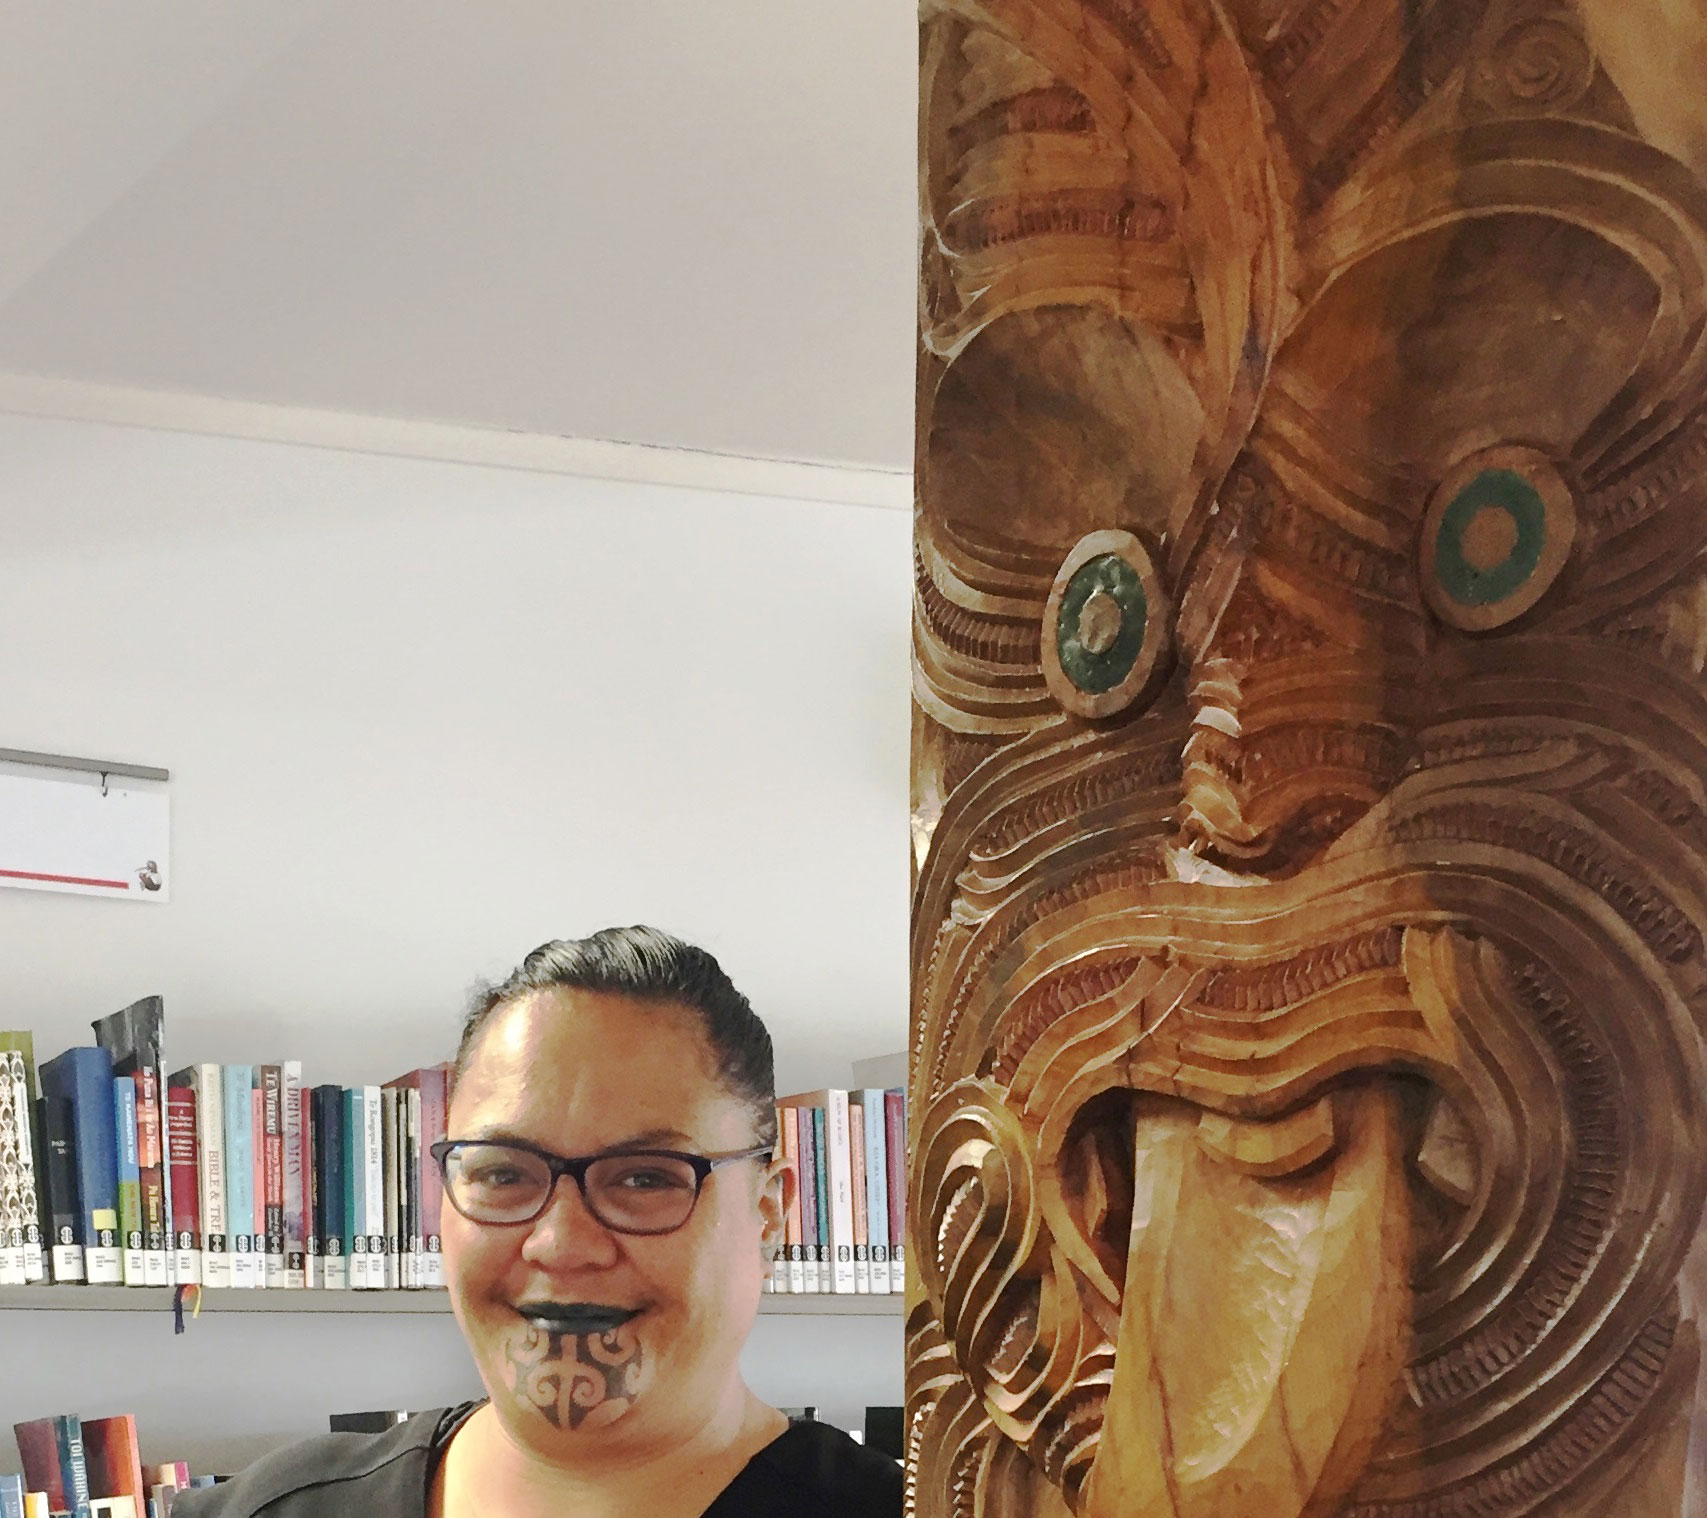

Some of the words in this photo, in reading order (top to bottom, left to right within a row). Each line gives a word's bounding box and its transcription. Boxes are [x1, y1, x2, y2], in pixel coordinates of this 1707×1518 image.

[266, 1071, 278, 1086] TE
[286, 1074, 299, 1082] A
[266, 1088, 278, 1134] WIREMU
[287, 1088, 300, 1139] DRIVEN
[208, 1150, 220, 1187] BIBLE
[288, 1144, 301, 1176] MAN
[210, 1190, 220, 1200] &
[71, 1437, 82, 1458] TOI
[73, 1460, 88, 1510] WAHINE
